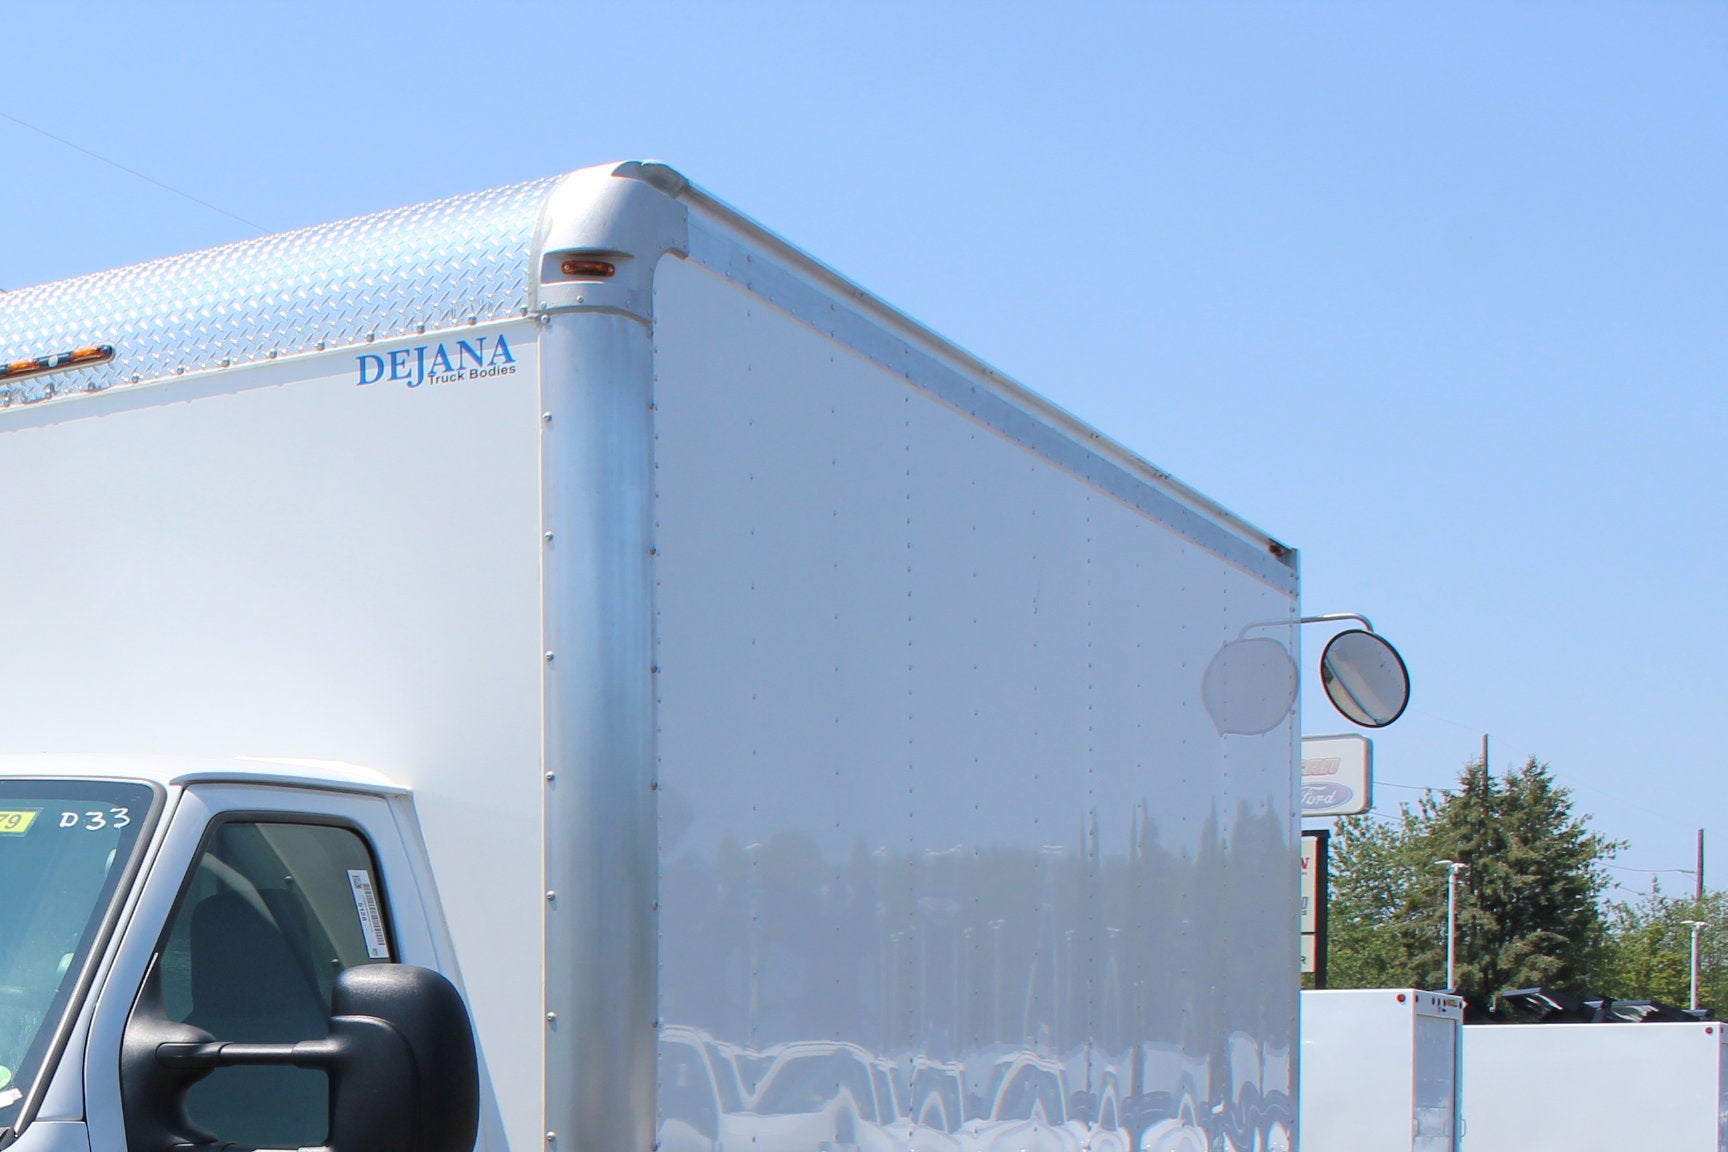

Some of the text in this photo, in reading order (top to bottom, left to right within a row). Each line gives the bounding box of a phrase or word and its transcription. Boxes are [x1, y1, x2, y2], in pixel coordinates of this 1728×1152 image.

[355, 333, 516, 388] DEJANA
[427, 364, 516, 385] Truck Bodies
